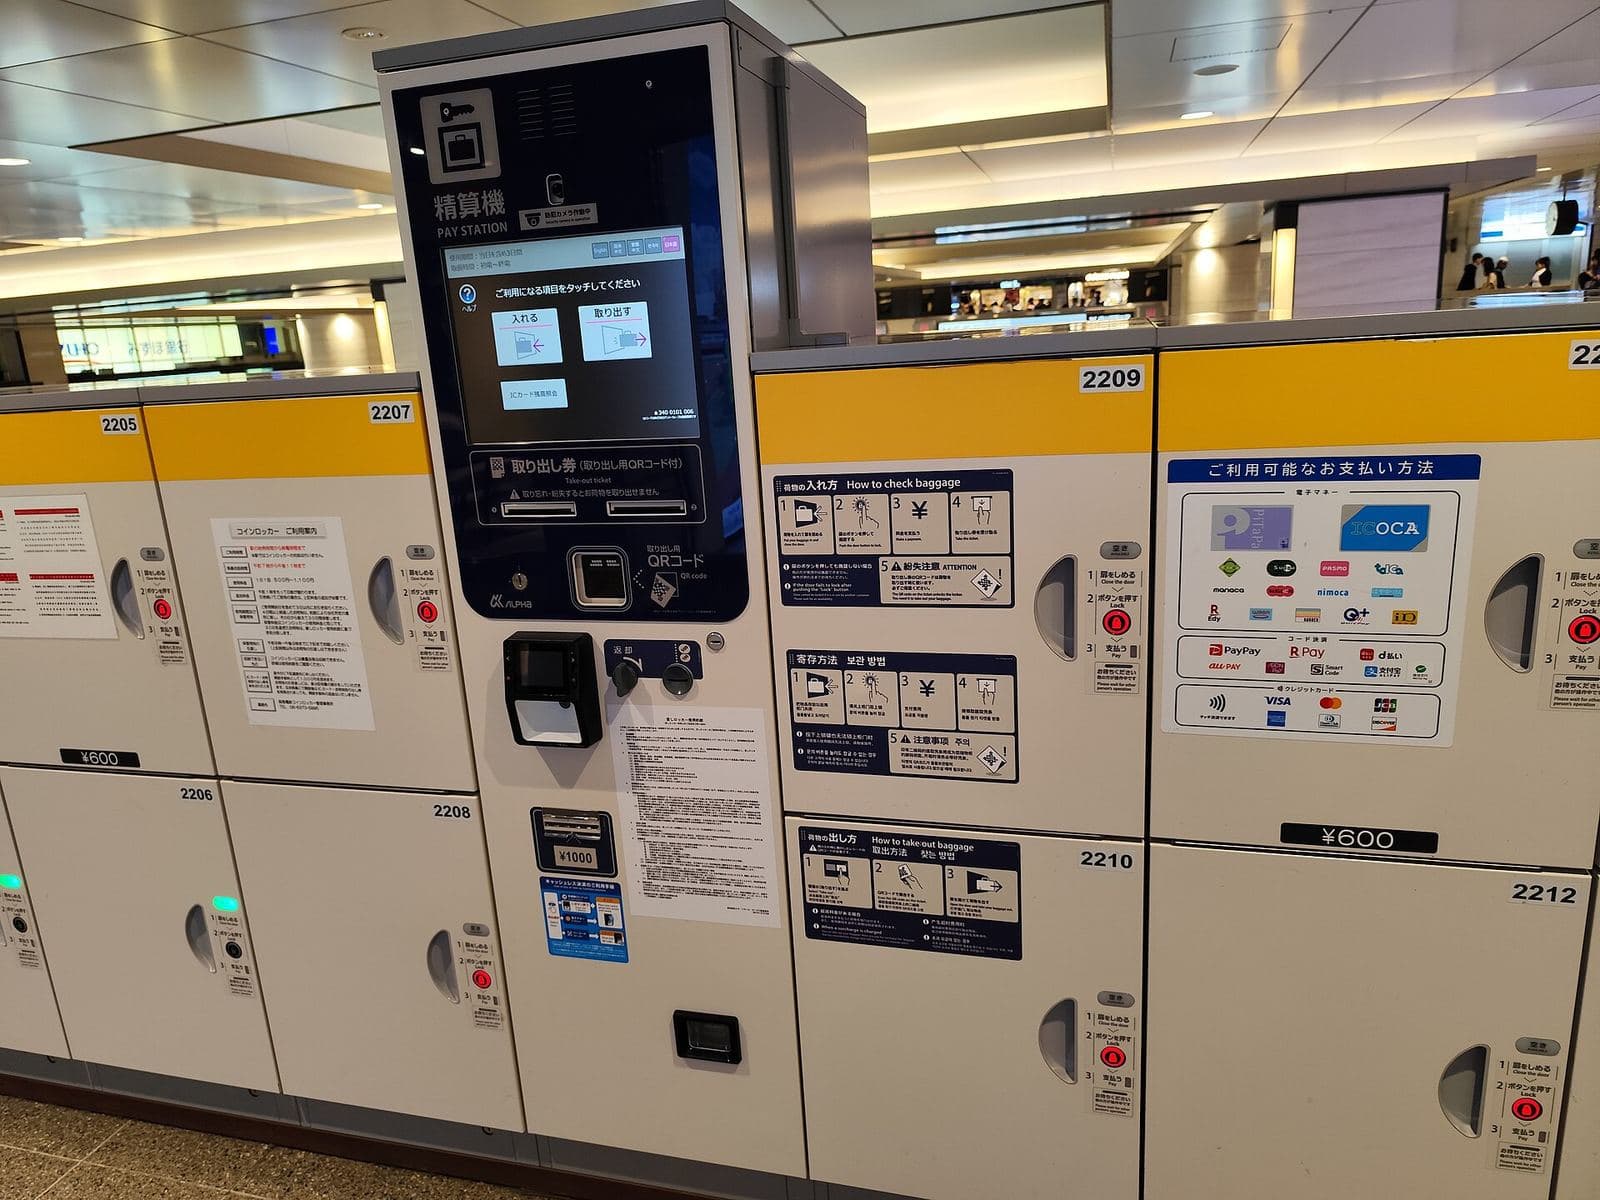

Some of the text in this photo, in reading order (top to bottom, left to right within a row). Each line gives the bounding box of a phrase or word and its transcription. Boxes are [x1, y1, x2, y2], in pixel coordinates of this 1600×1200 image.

[434, 189, 506, 222] 精算機
[437, 221, 508, 240] PAY STATION
[495, 279, 641, 299] ご利用になる項目をタッチしてください
[461, 303, 477, 312] ヘルプ
[594, 306, 631, 319] 取り出す
[511, 313, 538, 324] 入れる
[1082, 368, 1141, 389] 2209
[371, 404, 411, 421] 2207
[102, 417, 137, 432] 2205
[511, 457, 577, 474] 取り出し券
[1208, 460, 1434, 478] ご利用可能なお支払い方法
[565, 477, 593, 485] Take-out
[783, 477, 961, 493] 荷物の入れ方 How to check baggage
[1295, 488, 1339, 496] 電子マネー
[780, 500, 786, 511] 1
[835, 499, 844, 511] 2
[893, 498, 901, 510] 3
[952, 496, 961, 508] 4
[236, 527, 318, 536] コインロッカー ご利用案内
[1351, 522, 1420, 535] ICOCA
[646, 544, 681, 554] 取り出し用
[1112, 544, 1128, 552] 空き
[648, 553, 705, 569] QRコード
[881, 560, 888, 572] 5
[903, 562, 977, 571] 紛失注意 ATTENTION
[680, 572, 708, 580] QR code
[1087, 571, 1136, 579] 1 扉をしめる
[1555, 572, 1561, 581] 1
[1317, 588, 1349, 597] nimoca
[1087, 594, 1094, 603] 2
[1551, 598, 1559, 608] 2
[1208, 615, 1221, 623] Edy
[613, 646, 633, 656] 返却
[1086, 643, 1127, 652] 3 支払う
[1224, 645, 1261, 657] PayPay
[1302, 647, 1325, 659] Pay
[796, 654, 886, 666] 寄存方法 보관 방법
[1378, 650, 1403, 660] d払い
[1545, 653, 1595, 664] 3 支払う
[1208, 662, 1226, 670] au
[793, 672, 799, 682] 1
[846, 673, 853, 684] 2
[901, 675, 909, 687] 3
[958, 677, 967, 688] 4
[1284, 685, 1334, 694] クレジットカード
[1264, 696, 1291, 706] VISA
[890, 733, 897, 744] 5
[954, 737, 970, 747] 주의
[81, 751, 119, 766] ¥600
[180, 787, 214, 802] 2206
[433, 804, 471, 819] 2208
[807, 833, 857, 845] 荷物の出し方
[1322, 827, 1394, 849] ¥600
[871, 835, 889, 845] How
[889, 838, 901, 846] to
[937, 840, 975, 853] baggage
[872, 845, 908, 857] 取出方法
[559, 850, 592, 864] ¥1000
[805, 856, 811, 866] 1
[1080, 851, 1133, 869] 2210
[875, 862, 882, 873] 2
[947, 869, 954, 879] 3
[1511, 883, 1577, 904] 2212
[1086, 1032, 1132, 1043] 2 ボタンを押す
